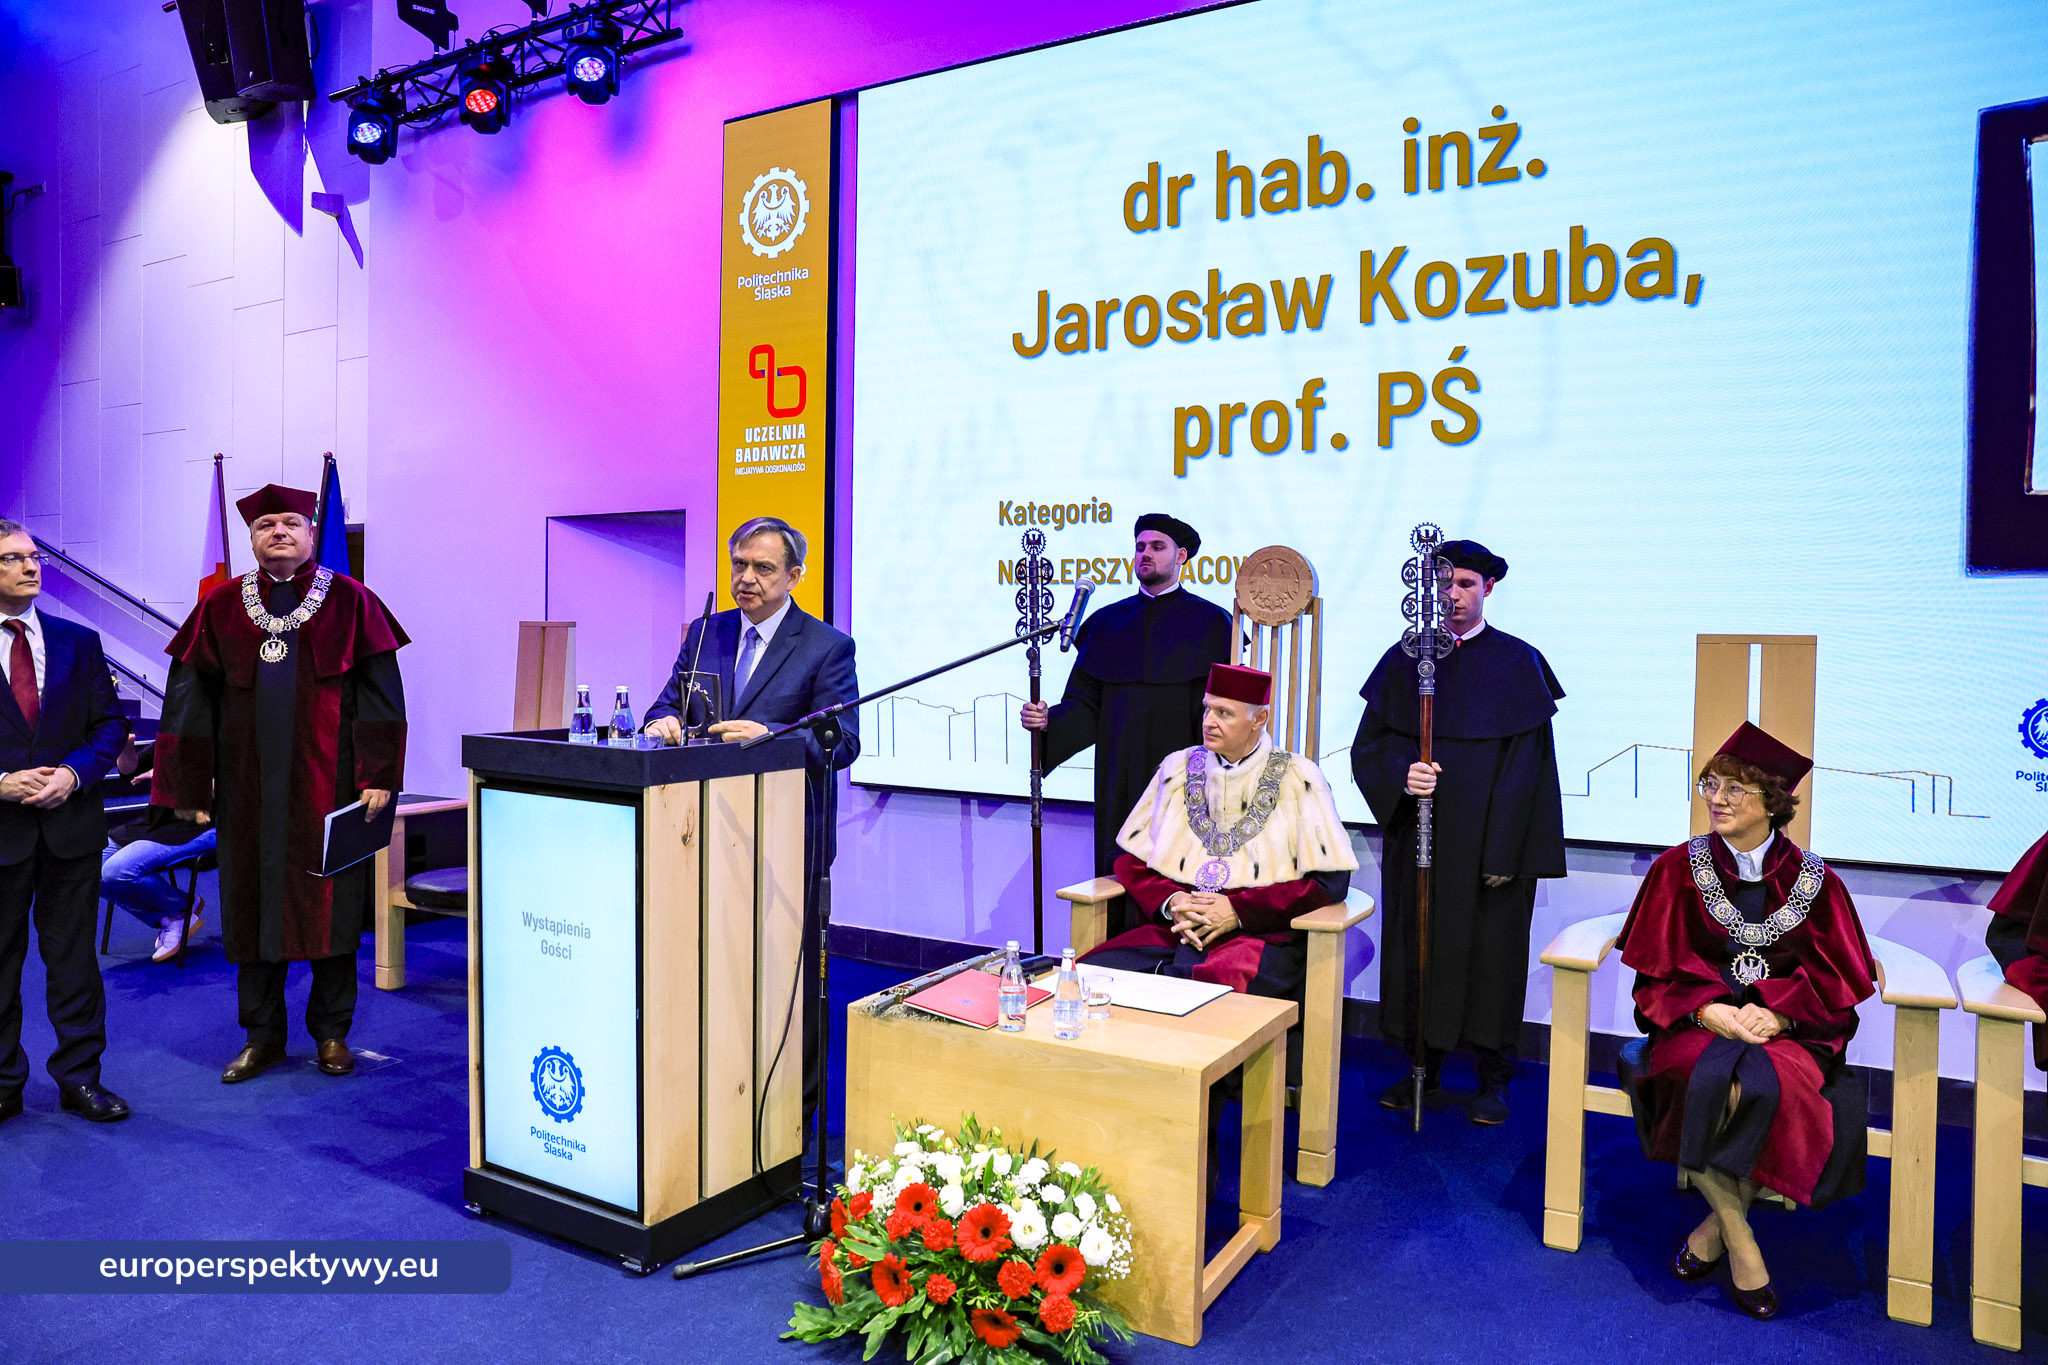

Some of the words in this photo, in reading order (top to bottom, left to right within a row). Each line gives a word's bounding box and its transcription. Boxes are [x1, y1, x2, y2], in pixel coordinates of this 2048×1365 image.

[1124, 161, 1193, 232] dr
[1216, 134, 1374, 221] hab.
[1403, 105, 1546, 193] inż.
[737, 267, 809, 289] Politechnika
[1012, 268, 1332, 358] Jarosław
[1360, 225, 1703, 324] Kozuba,
[754, 284, 792, 301] Śląska
[1173, 377, 1348, 477] prof.
[1378, 345, 1480, 447] PŚ
[745, 423, 806, 443] UCZELNIA
[735, 443, 806, 463] BADAWCZA
[999, 496, 1112, 531] Kategoria
[522, 910, 591, 939] Wystąpienia
[541, 939, 572, 960] Gości
[530, 1126, 586, 1153] Politechnika
